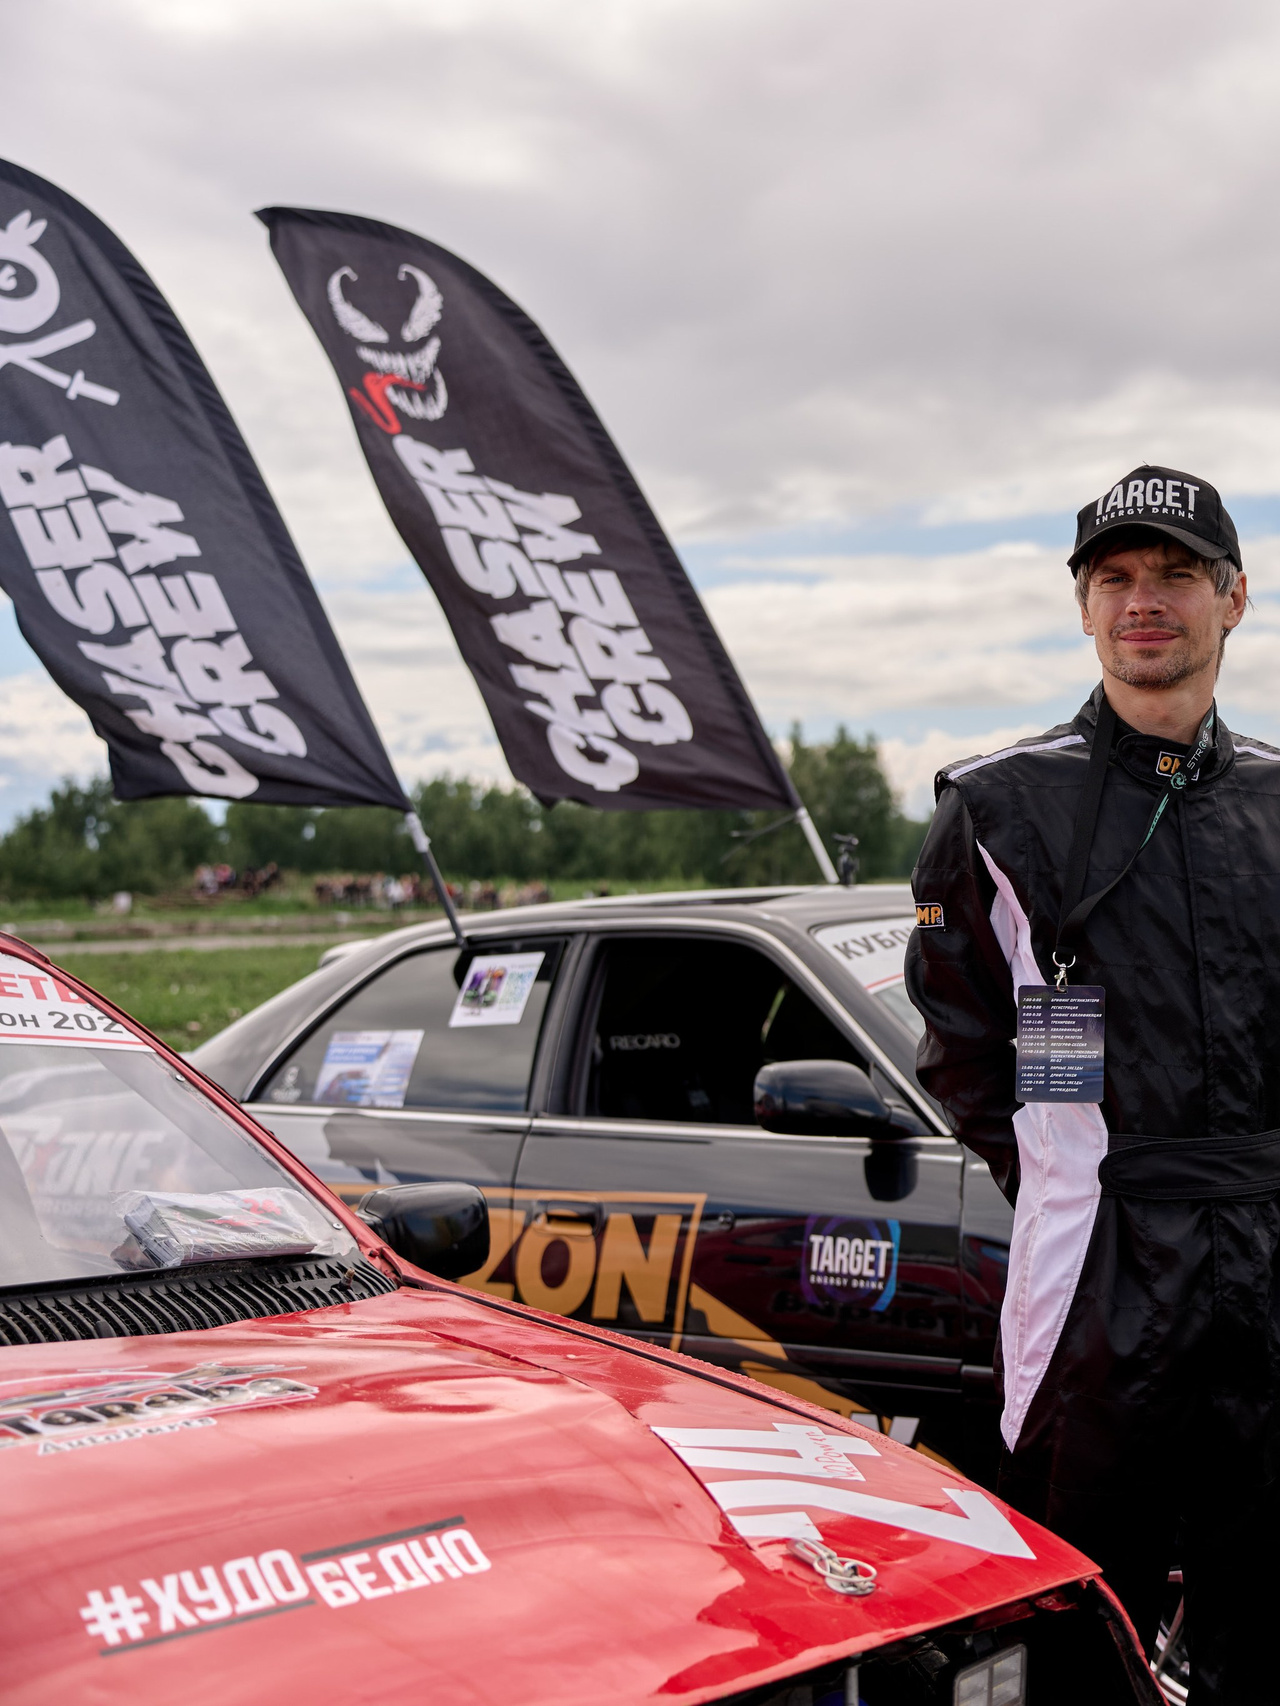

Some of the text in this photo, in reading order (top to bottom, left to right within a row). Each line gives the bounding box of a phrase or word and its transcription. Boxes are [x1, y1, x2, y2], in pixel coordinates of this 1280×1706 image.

[1095, 507, 1195, 526] ENERGY DRINK
[1096, 478, 1199, 516] TARGET
[79, 464, 307, 758] CREW
[392, 434, 639, 792] CHASER
[482, 475, 694, 745] CREW
[833, 927, 912, 960] КУБО
[809, 1234, 893, 1279] TARGET
[809, 1273, 885, 1291] ENERGY DRINK
